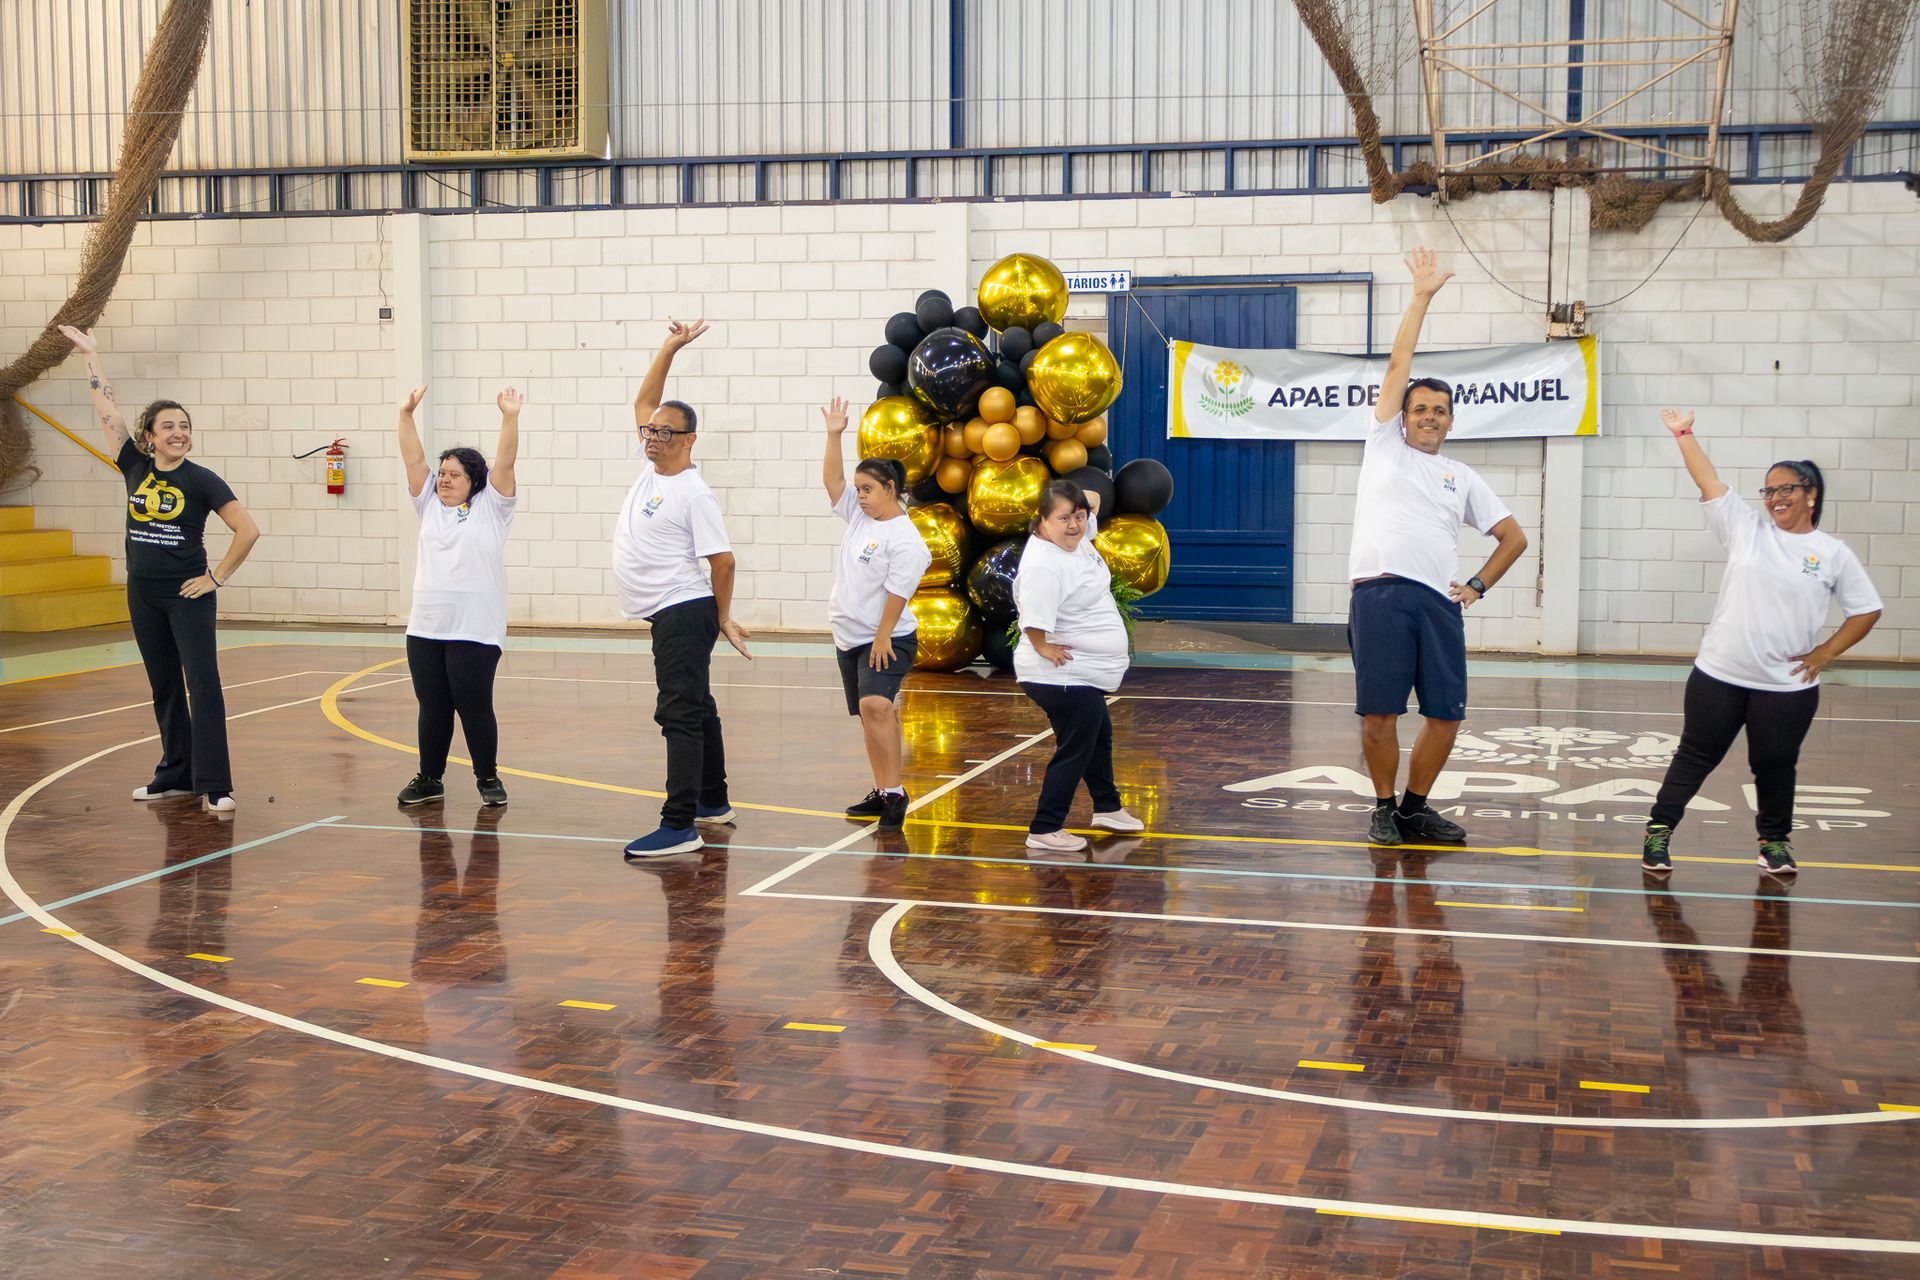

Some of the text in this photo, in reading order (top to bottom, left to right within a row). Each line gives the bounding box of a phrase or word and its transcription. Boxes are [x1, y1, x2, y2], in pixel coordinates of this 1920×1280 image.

[1067, 275, 1107, 289] TÁRIOS
[1268, 378, 1570, 408] APAE DE MANUEL
[1222, 765, 1892, 817] APAE
[1241, 797, 1378, 812] São
